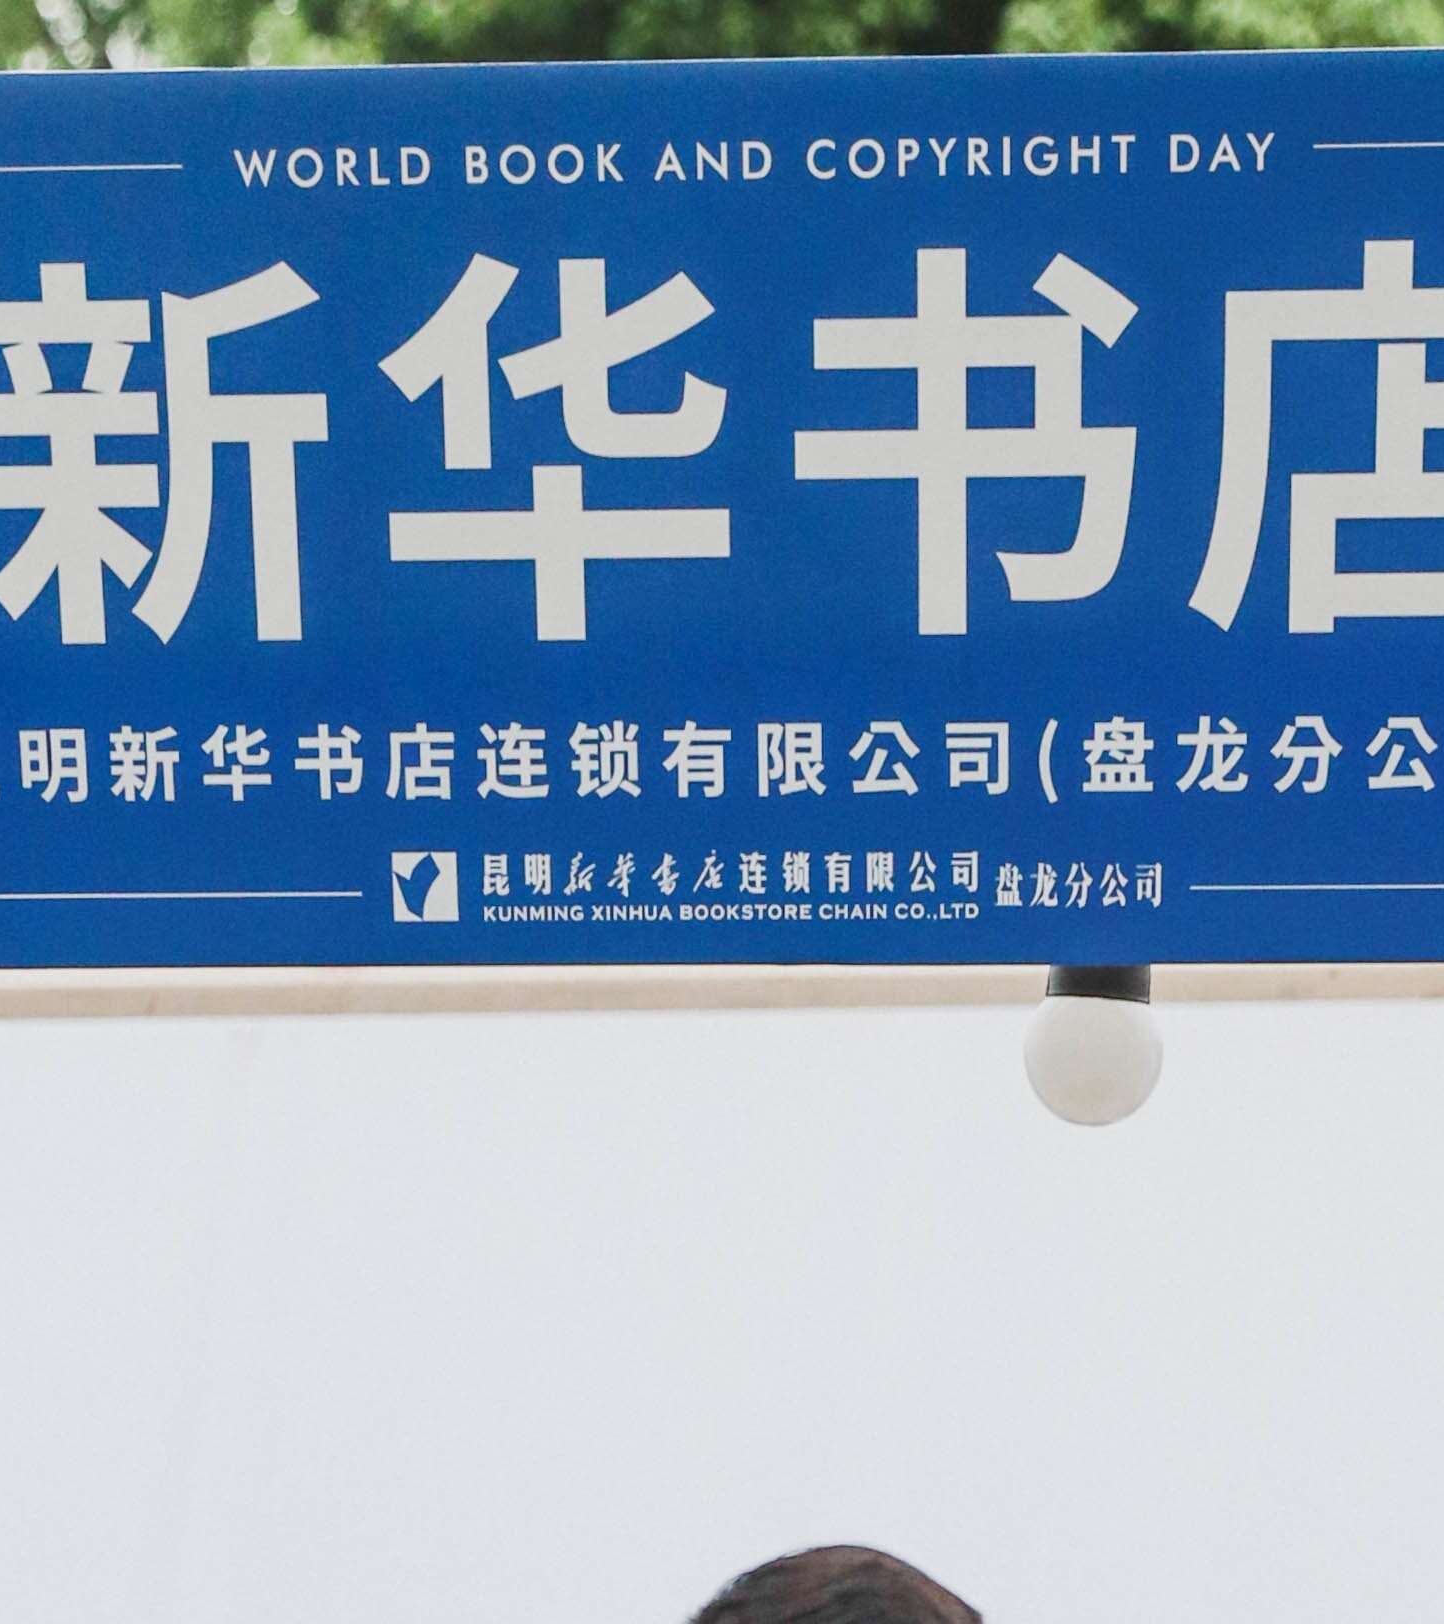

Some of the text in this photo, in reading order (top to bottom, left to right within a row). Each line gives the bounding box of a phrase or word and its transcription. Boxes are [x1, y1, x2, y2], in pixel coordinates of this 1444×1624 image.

[234, 131, 1277, 190] WORLD BOOK AND COPYRIGHT DAY
[483, 850, 1164, 908] 昆明新华书店连锁有限公司 盘龙分公司
[483, 905, 584, 923] KUNMING
[591, 905, 673, 923] XINHUA
[679, 904, 813, 922] BOOKSTORE
[819, 904, 888, 921] CHAIN
